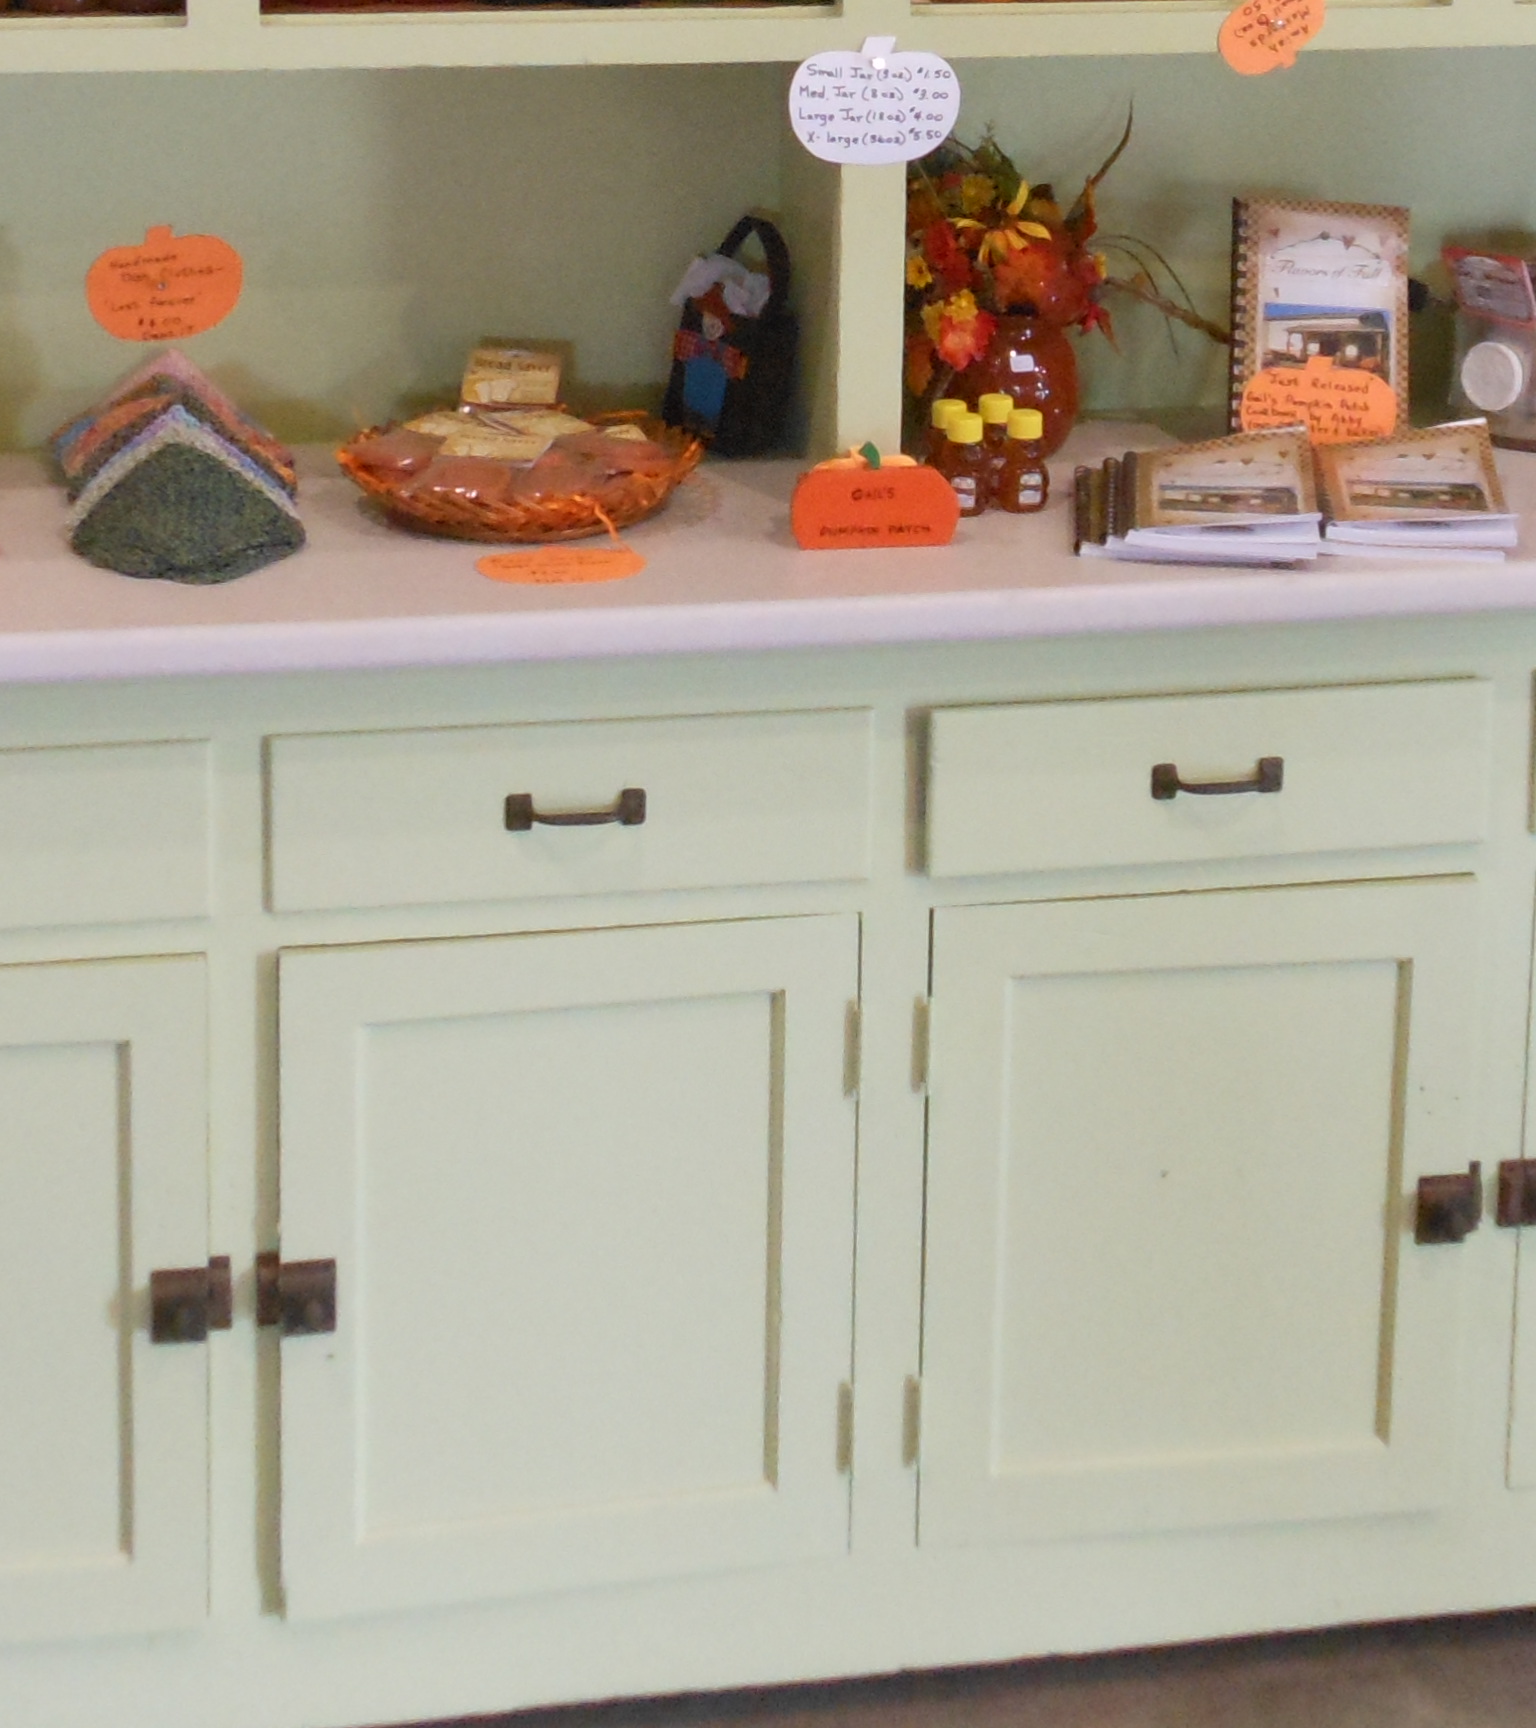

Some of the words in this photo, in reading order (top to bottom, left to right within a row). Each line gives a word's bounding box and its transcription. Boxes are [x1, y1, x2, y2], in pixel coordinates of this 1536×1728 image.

[807, 64, 842, 78] Small
[850, 67, 872, 80] Jar
[799, 85, 829, 101] Med.
[833, 86, 856, 99] Jar
[799, 107, 835, 126] Large
[839, 108, 863, 122] Jar
[1269, 373, 1298, 387] Just
[1311, 377, 1369, 394] Released
